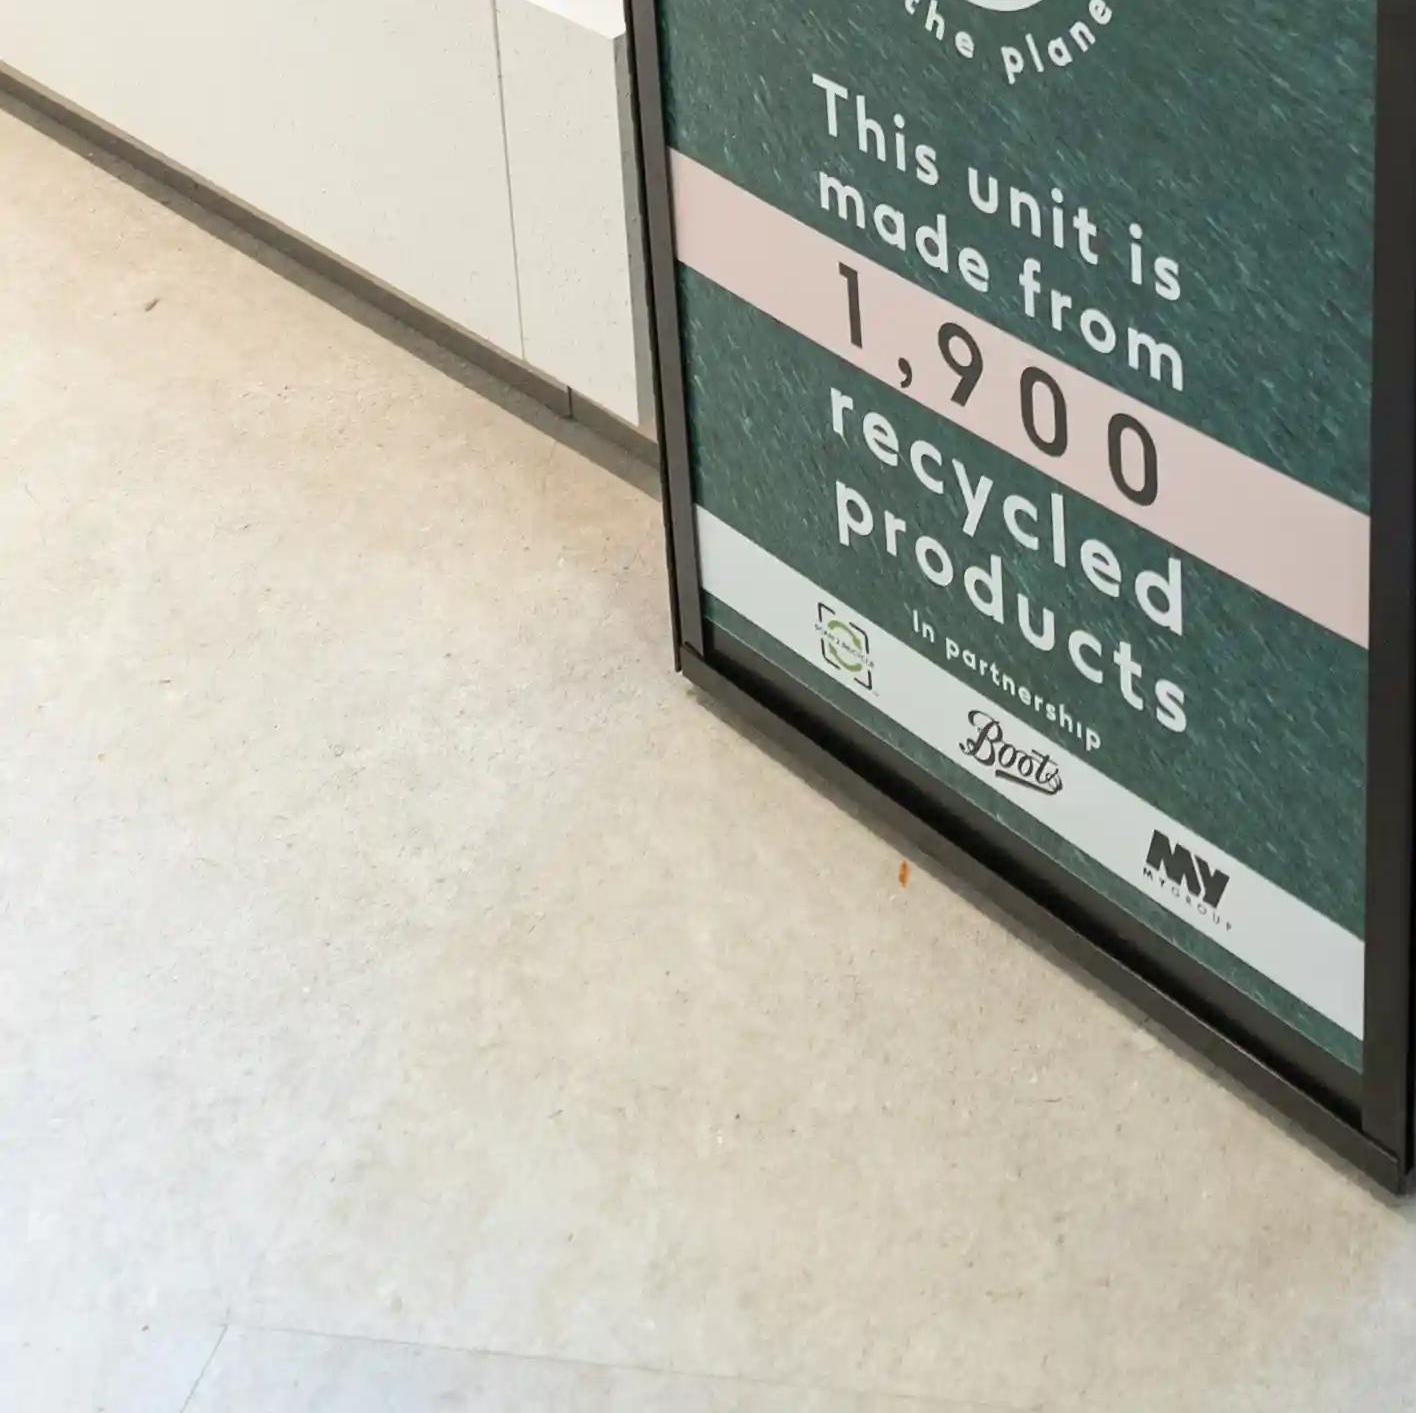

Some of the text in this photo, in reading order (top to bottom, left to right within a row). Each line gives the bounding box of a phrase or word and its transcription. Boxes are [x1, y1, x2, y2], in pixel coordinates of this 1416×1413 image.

[811, 73, 1183, 302] This unit is
[818, 169, 1186, 393] made from
[837, 260, 1160, 509] 1,900
[829, 385, 1185, 638] recycled
[835, 477, 1189, 735] products
[912, 609, 1102, 751] In partnership
[958, 709, 1063, 796] Boots
